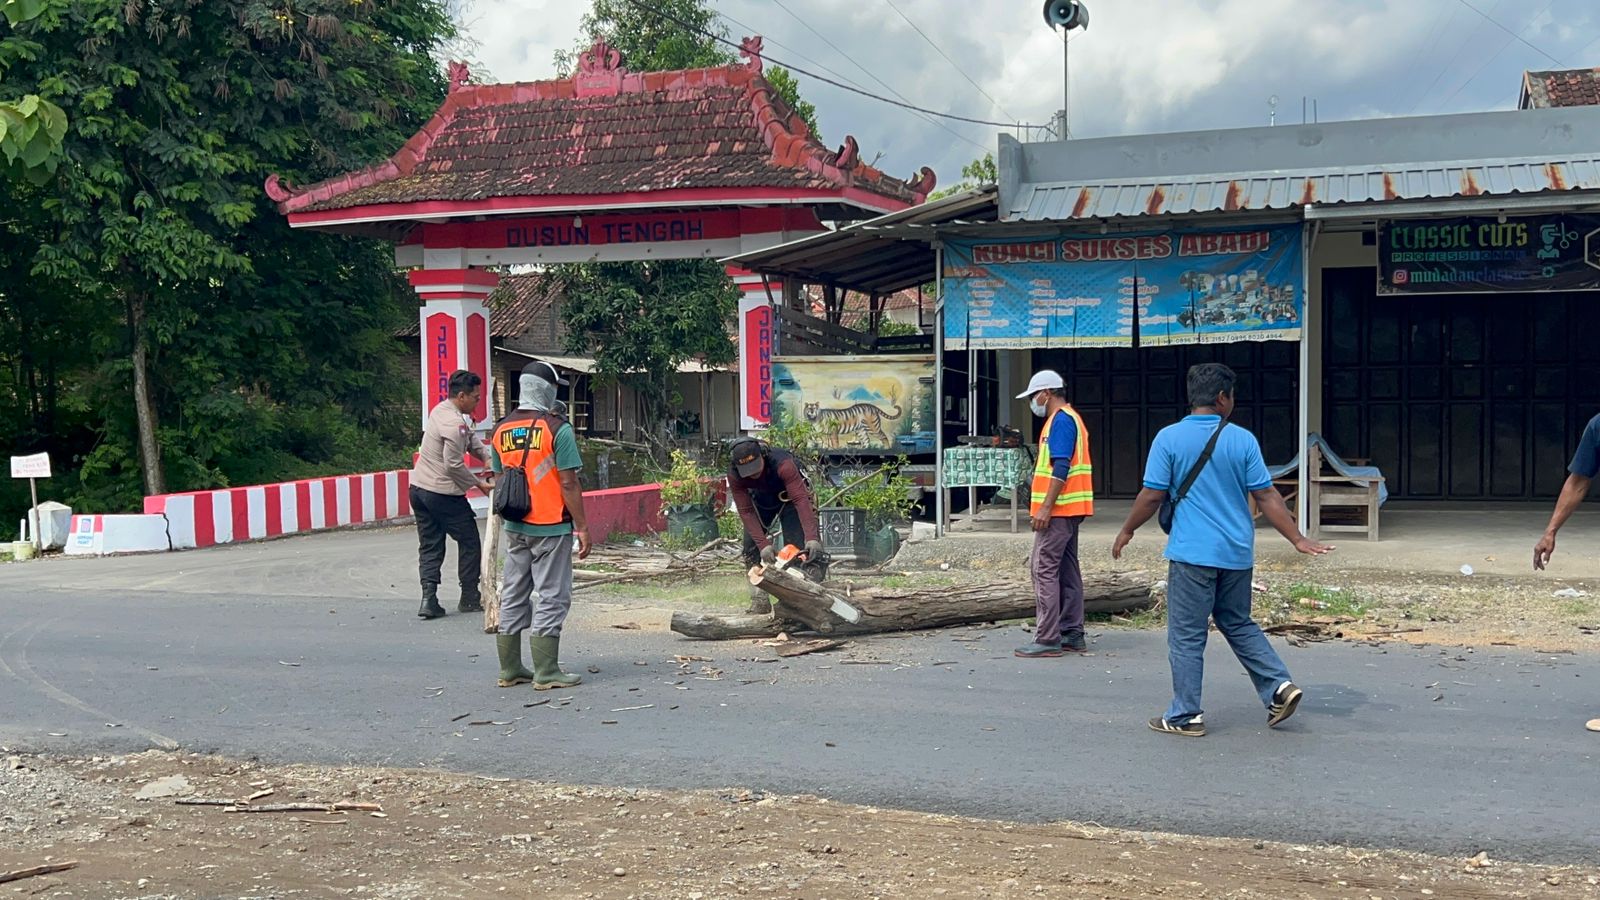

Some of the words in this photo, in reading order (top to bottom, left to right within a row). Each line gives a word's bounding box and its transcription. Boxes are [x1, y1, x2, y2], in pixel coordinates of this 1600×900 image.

[507, 223, 589, 247] DUSUN
[603, 219, 702, 243] TENGAH
[973, 243, 1056, 264] KUNCI
[1062, 235, 1172, 261] SUKSES
[1178, 232, 1269, 256] ABADI
[1391, 225, 1471, 249] CLASSIC
[1478, 224, 1527, 247] CUTS
[760, 310, 771, 418] JANOKO
